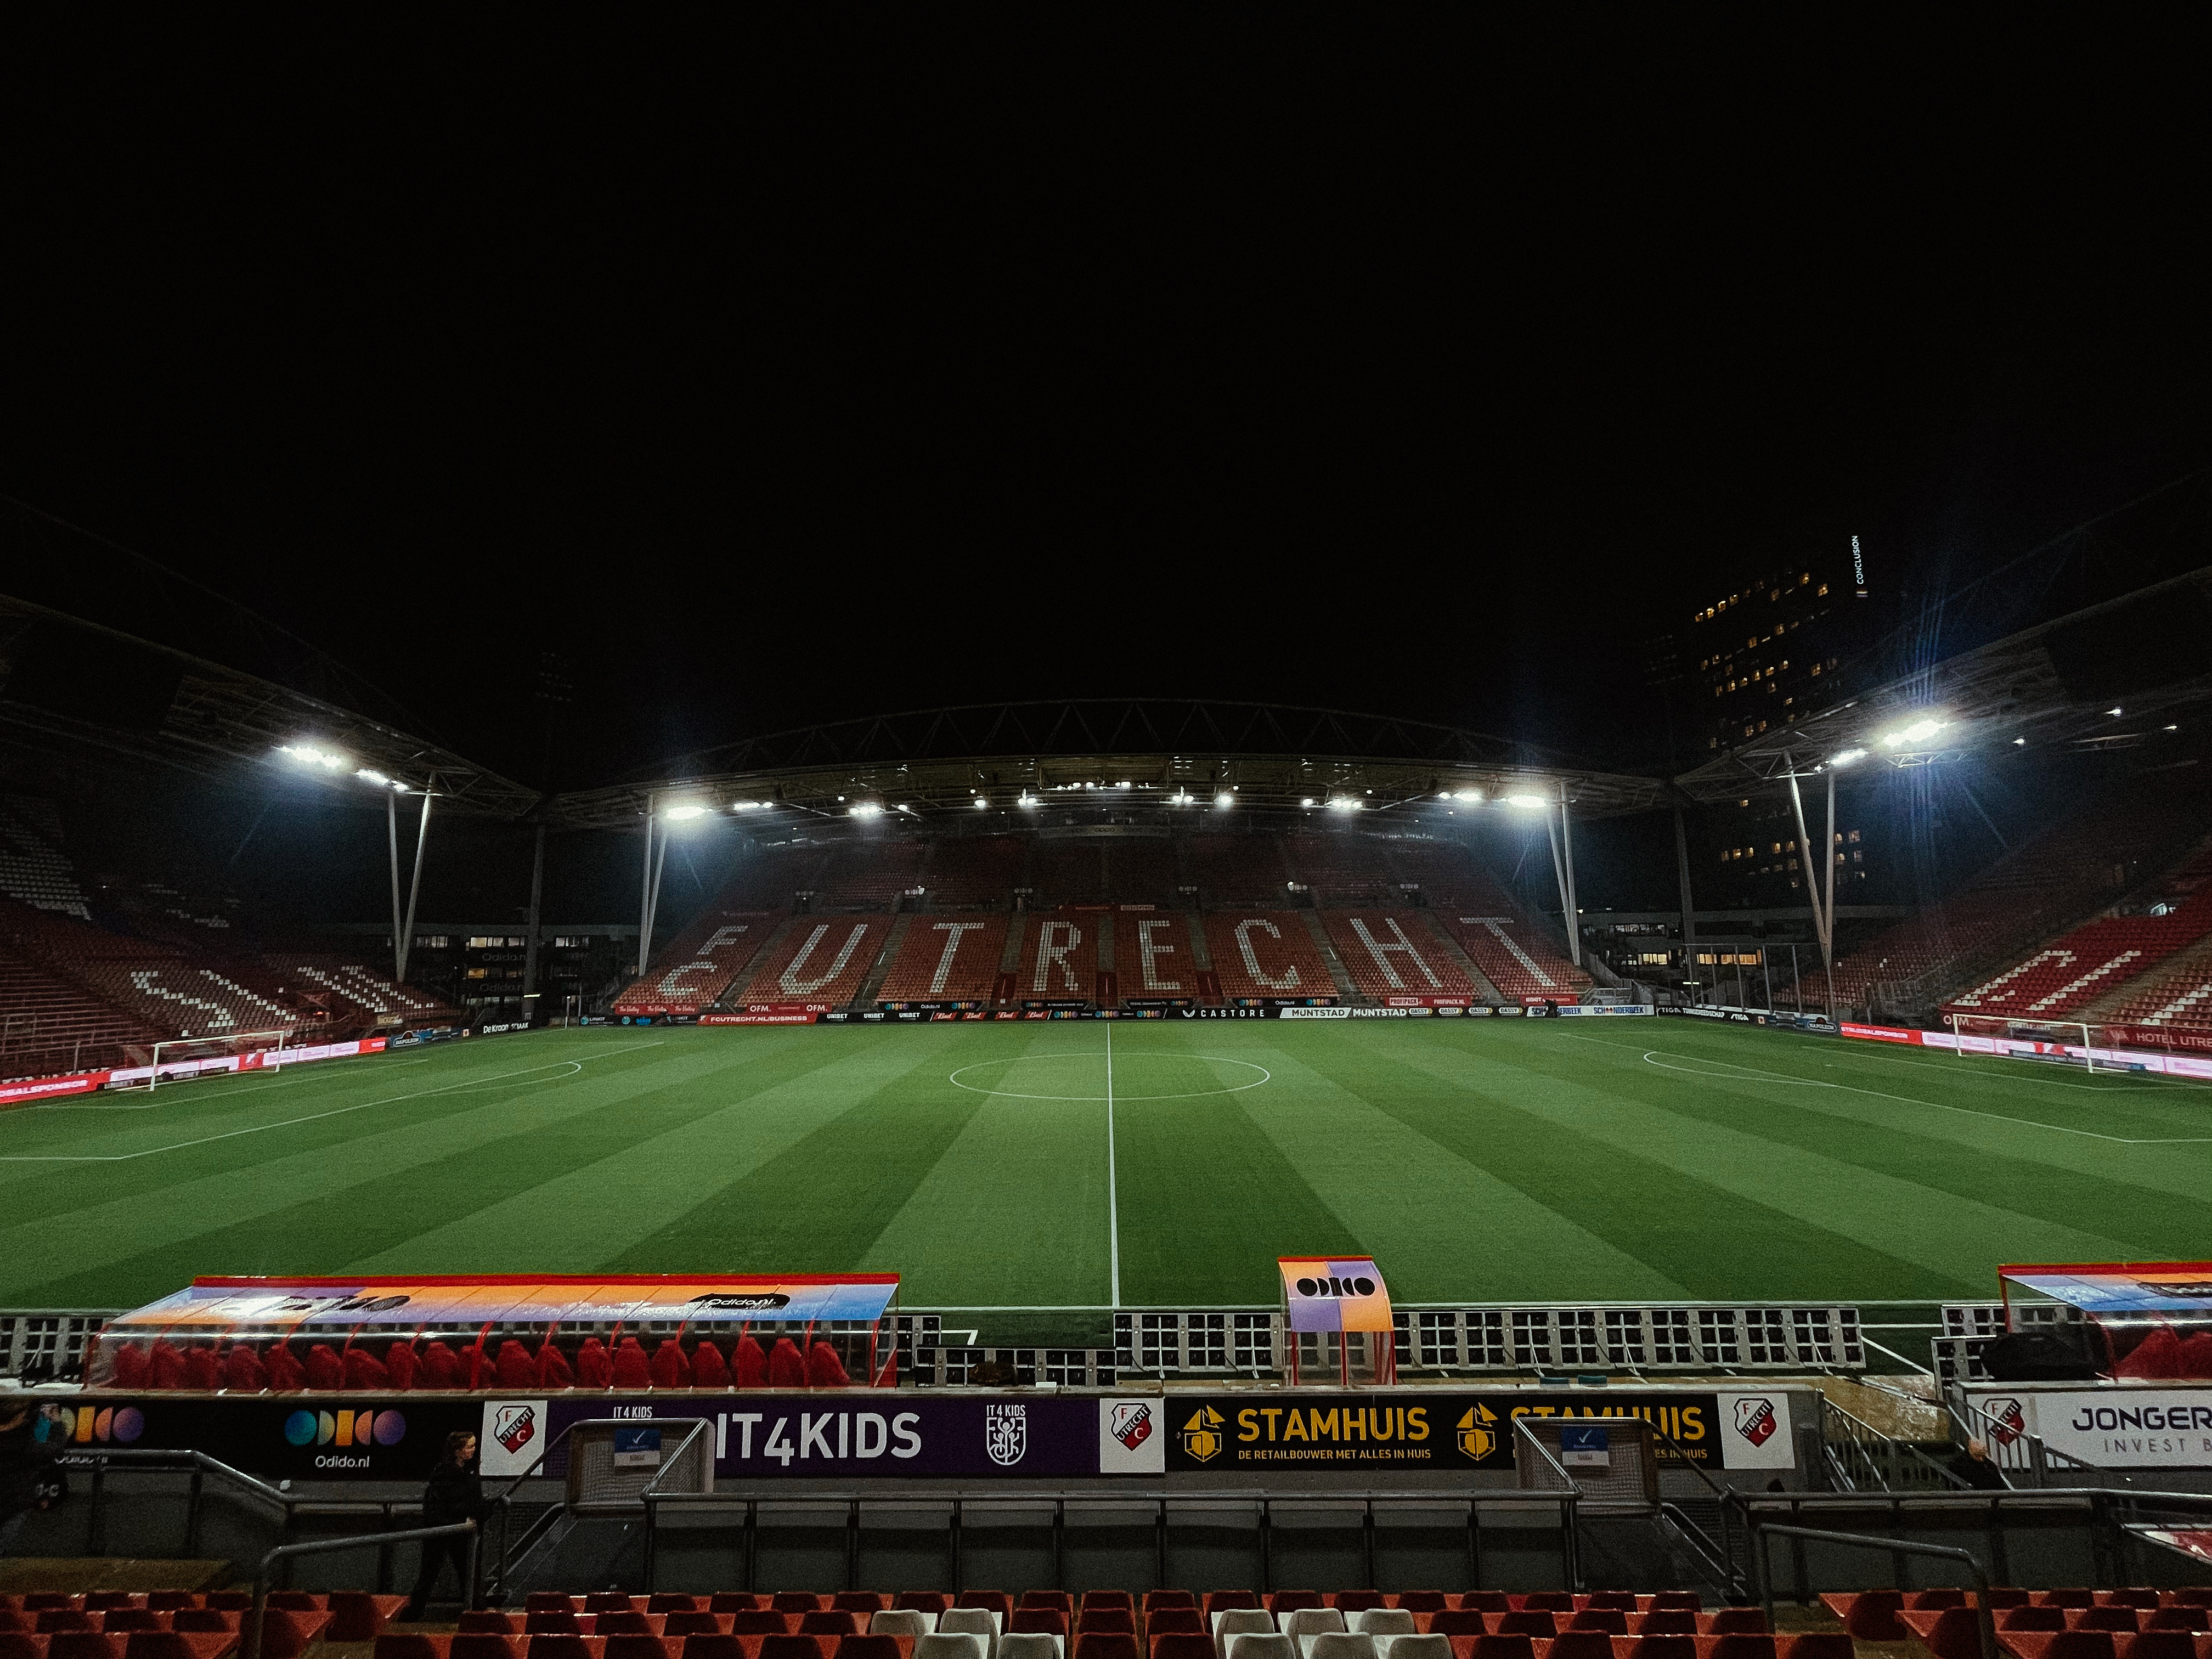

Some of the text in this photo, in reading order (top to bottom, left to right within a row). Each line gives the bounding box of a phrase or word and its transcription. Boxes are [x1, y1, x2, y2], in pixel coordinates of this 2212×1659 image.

[1852, 535, 1864, 584] CONCLUSION
[482, 953, 526, 961] Odido.n
[480, 983, 523, 991] Odido.n
[1353, 1008, 1407, 1017] MUNTSTAD
[1943, 1015, 1973, 1027] OM.
[2136, 1032, 2177, 1045] HOTEL
[613, 1406, 652, 1418] IT 4 KIDS
[987, 1404, 1026, 1417] IT 4 KIDS
[1121, 1408, 1127, 1420] F
[1742, 1403, 1750, 1415] F
[505, 1410, 512, 1422] F
[1741, 1402, 1771, 1436] UTRECHT
[2072, 1406, 2212, 1431] JONGER
[499, 1409, 533, 1443] UTRECHT
[1117, 1406, 1148, 1441] UTRECHT
[1238, 1407, 1430, 1441] STAMHUIS
[1759, 1423, 1769, 1435] C
[517, 1430, 526, 1442] C
[716, 1412, 922, 1466] IT4KIDS
[1135, 1427, 1143, 1439] C
[2104, 1438, 2186, 1453] INVEST
[1239, 1449, 1431, 1459] DE RETAILBOUWER MET ALLES IN HUIS
[315, 1455, 370, 1468] Odido.nl
